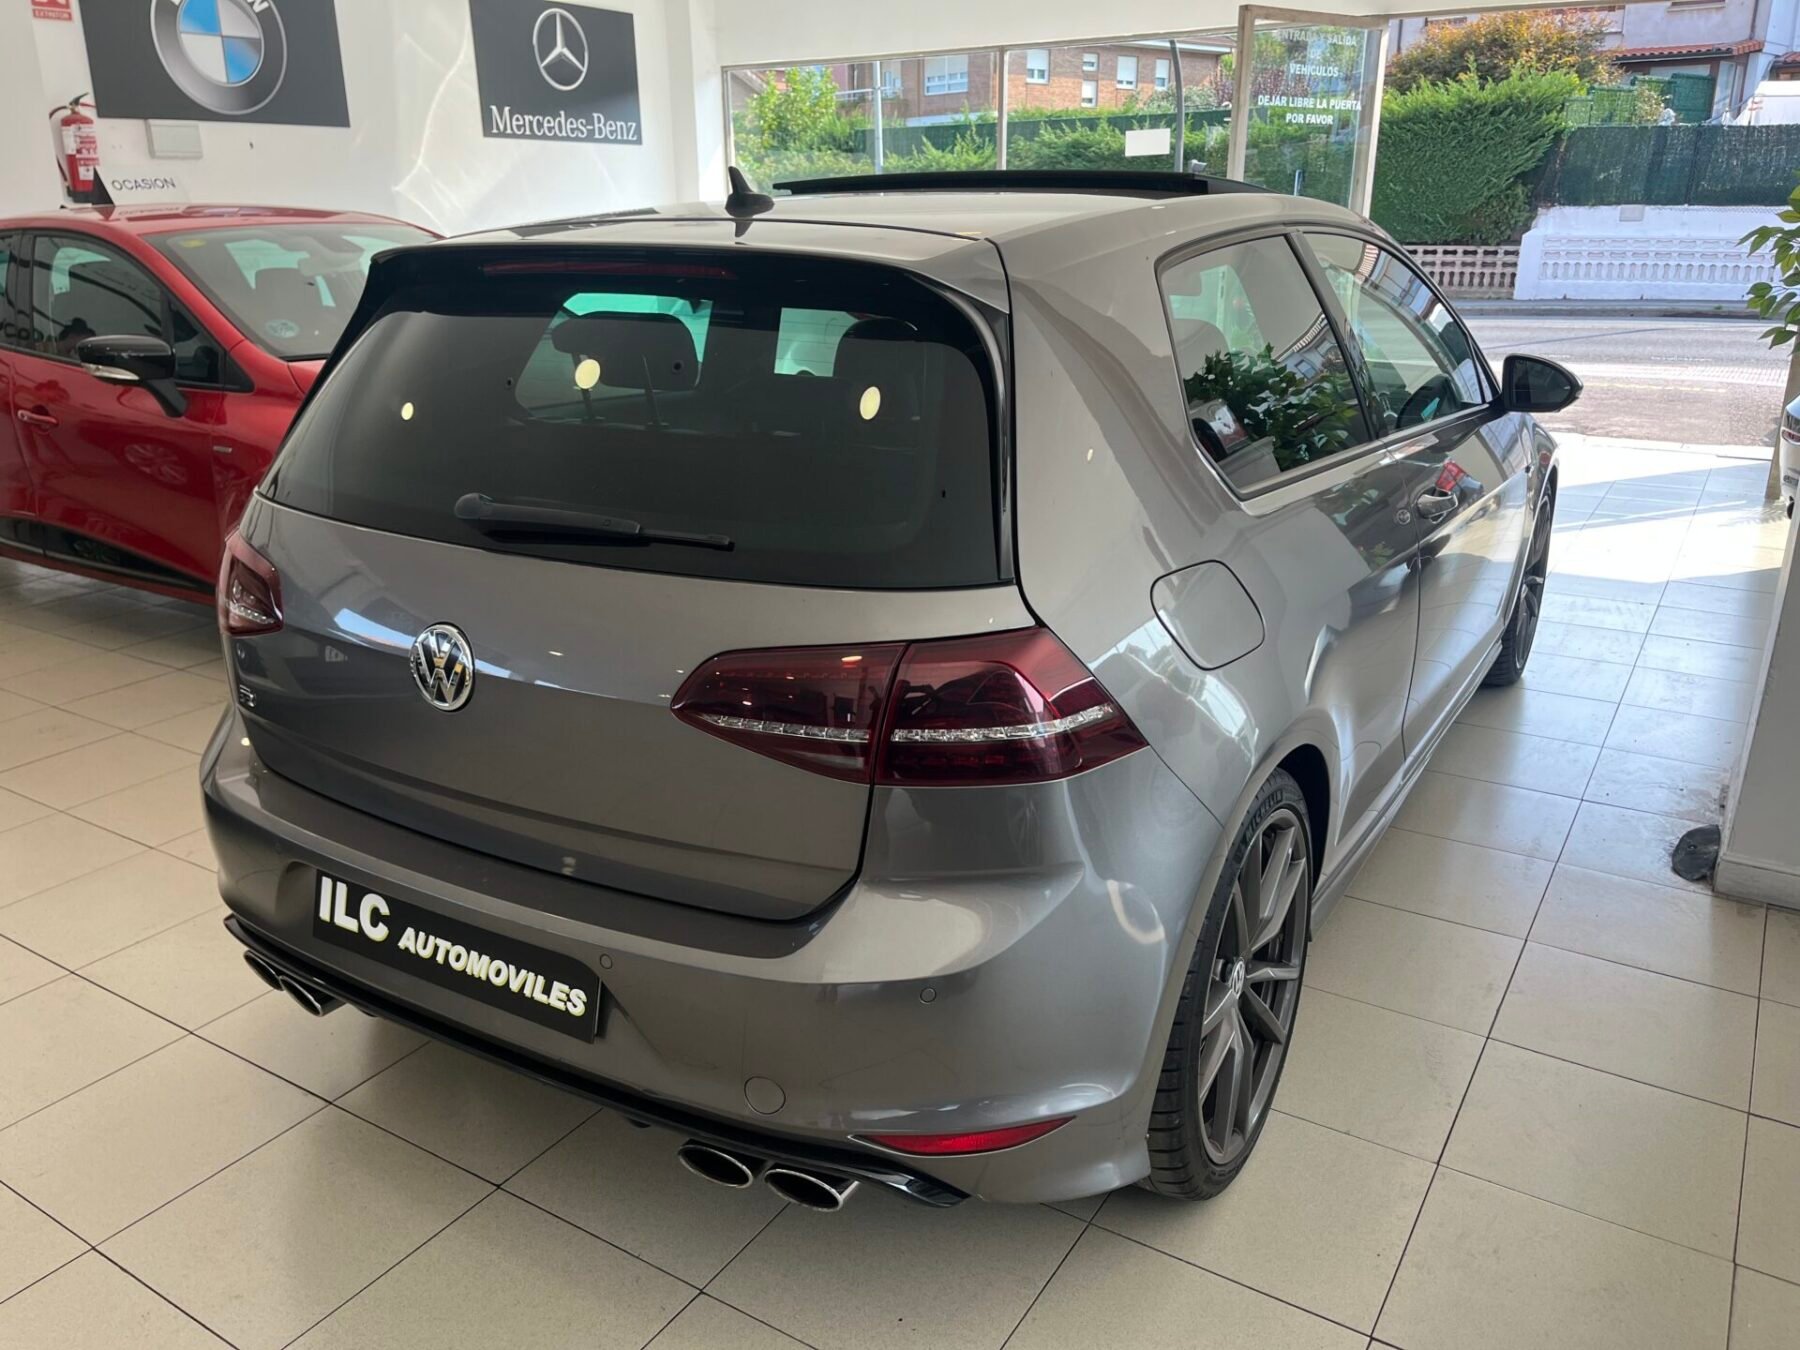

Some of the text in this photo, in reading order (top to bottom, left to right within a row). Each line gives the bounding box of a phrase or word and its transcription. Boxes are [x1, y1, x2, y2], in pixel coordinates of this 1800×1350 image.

[1328, 33, 1357, 46] SALIDA
[1289, 63, 1339, 77] VEHICULOS
[1258, 95, 1362, 110] DEJAR LIBRE LA PUERTA
[489, 105, 638, 141] Mercedes-Benz
[1286, 113, 1334, 125] POR FAVOR
[112, 177, 176, 191] OCASION
[319, 876, 587, 1017] ILC AUTOMOVILES
